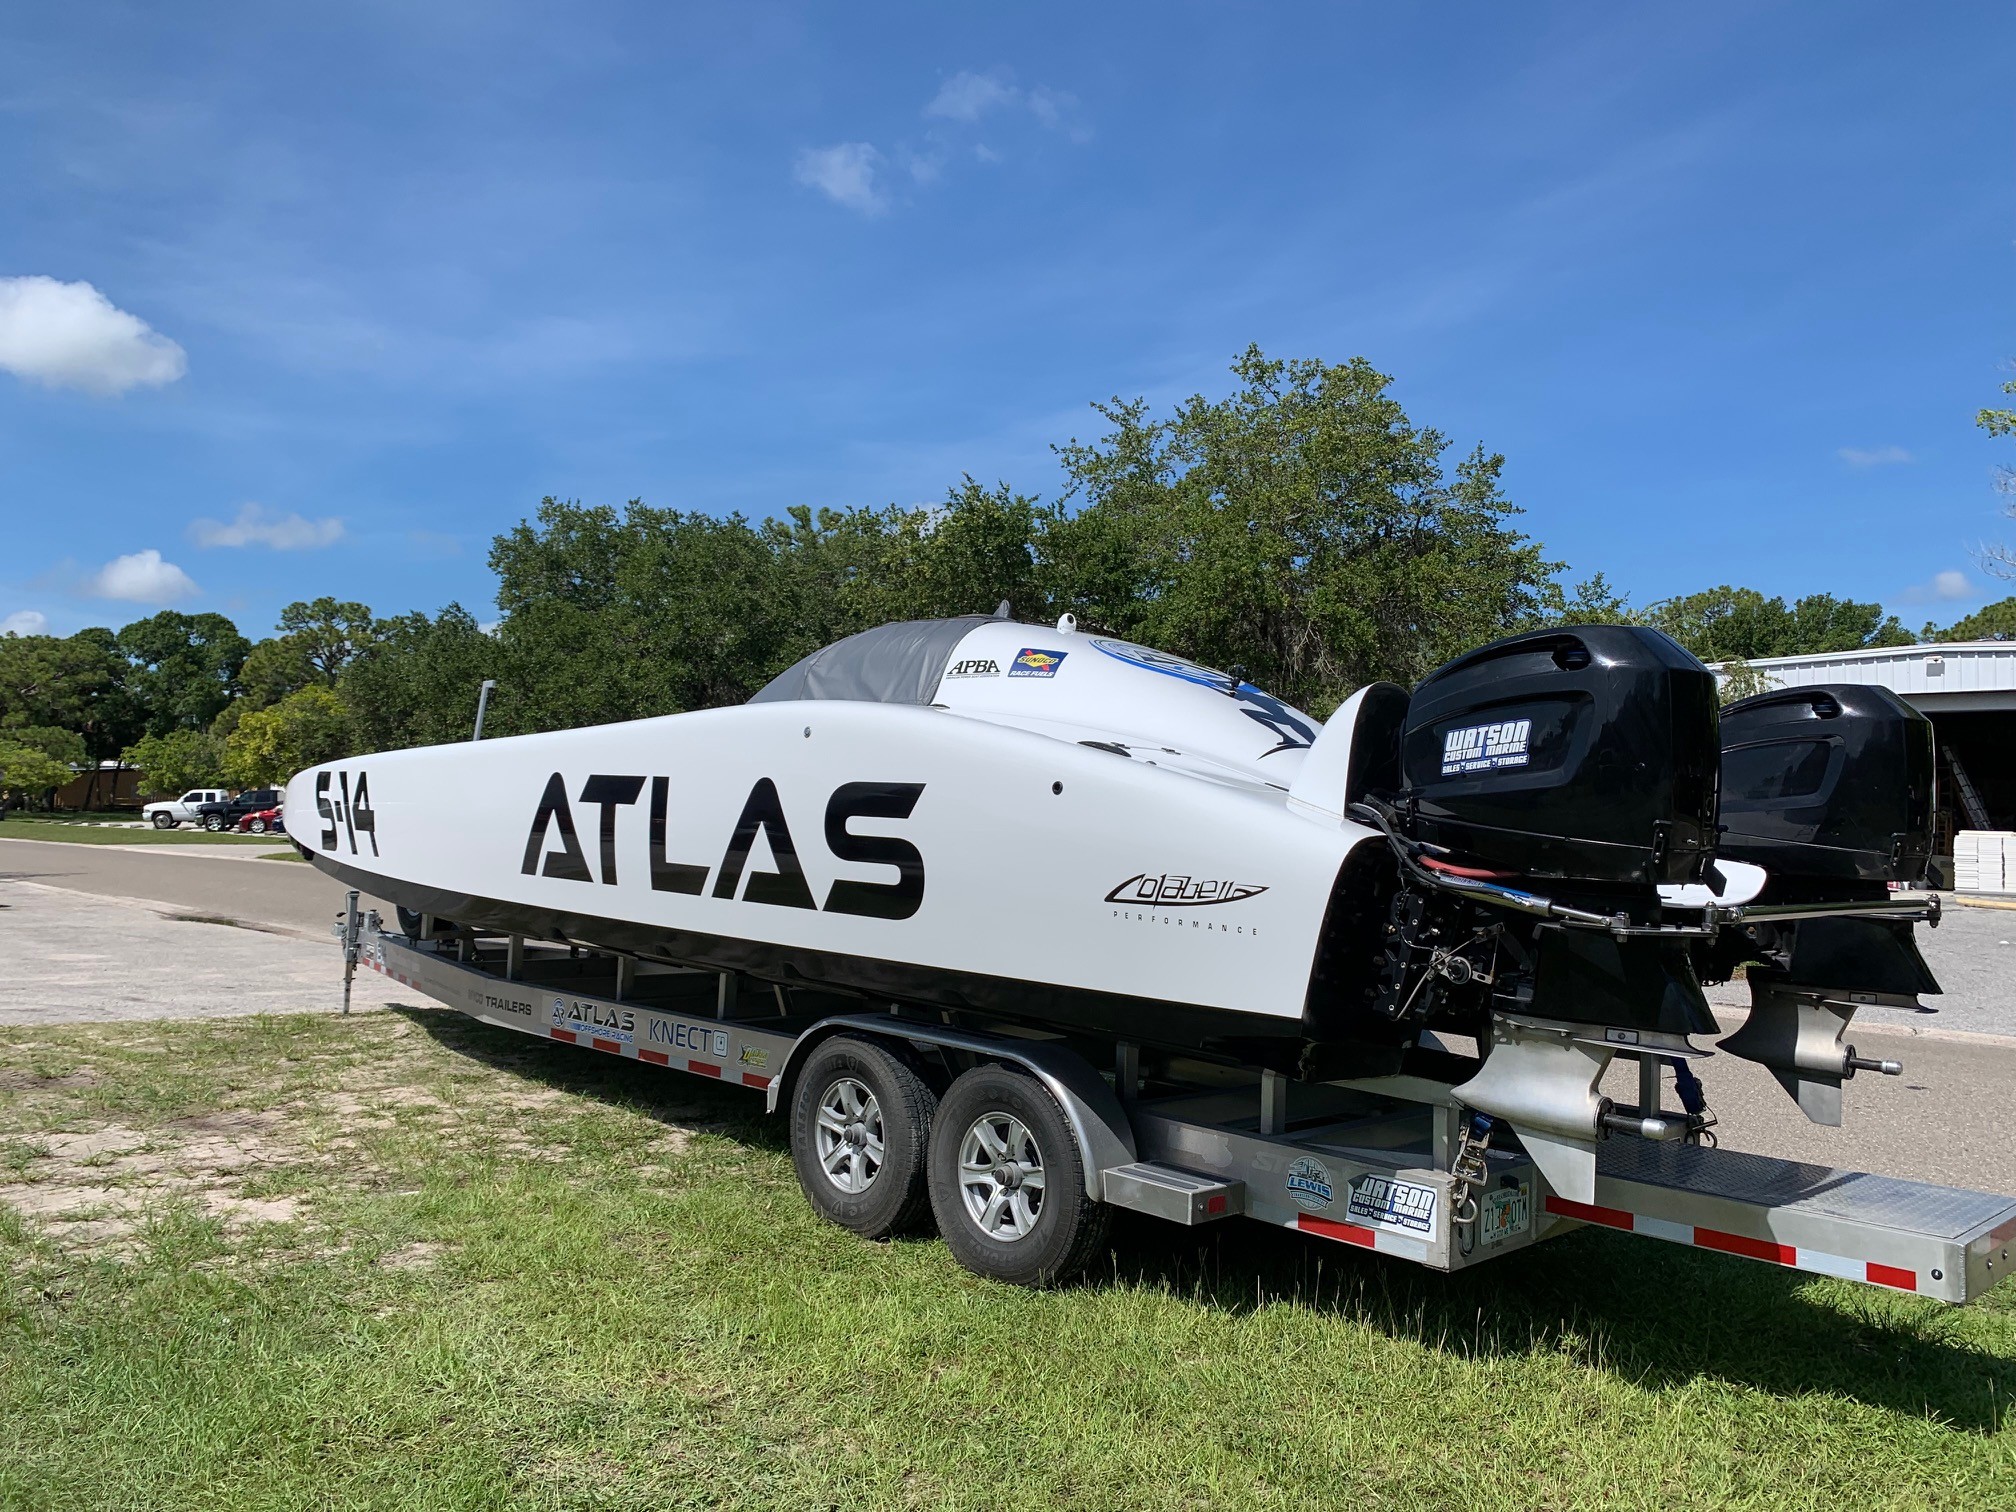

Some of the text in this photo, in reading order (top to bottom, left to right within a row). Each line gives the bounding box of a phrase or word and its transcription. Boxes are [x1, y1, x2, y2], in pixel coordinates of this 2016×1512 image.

[947, 660, 1001, 674] APBA
[1446, 721, 1530, 752] WATSON
[1442, 755, 1527, 774] SALES SERVICE STORAGE
[1444, 741, 1526, 763] CUSTOM MARINE
[521, 771, 927, 921] ATLAS
[1113, 910, 1258, 936] PERFORMANCE
[485, 995, 533, 1016] TRAILERS
[567, 1001, 636, 1032] ATLAS
[580, 1024, 633, 1043] OFFSHORE RACING
[1290, 1176, 1330, 1197] LEWIS
[1355, 1177, 1436, 1211] WATSON
[1350, 1204, 1431, 1231] SALES SERVICE STORAGE
[1352, 1193, 1431, 1220] CUSTOM MARINE
